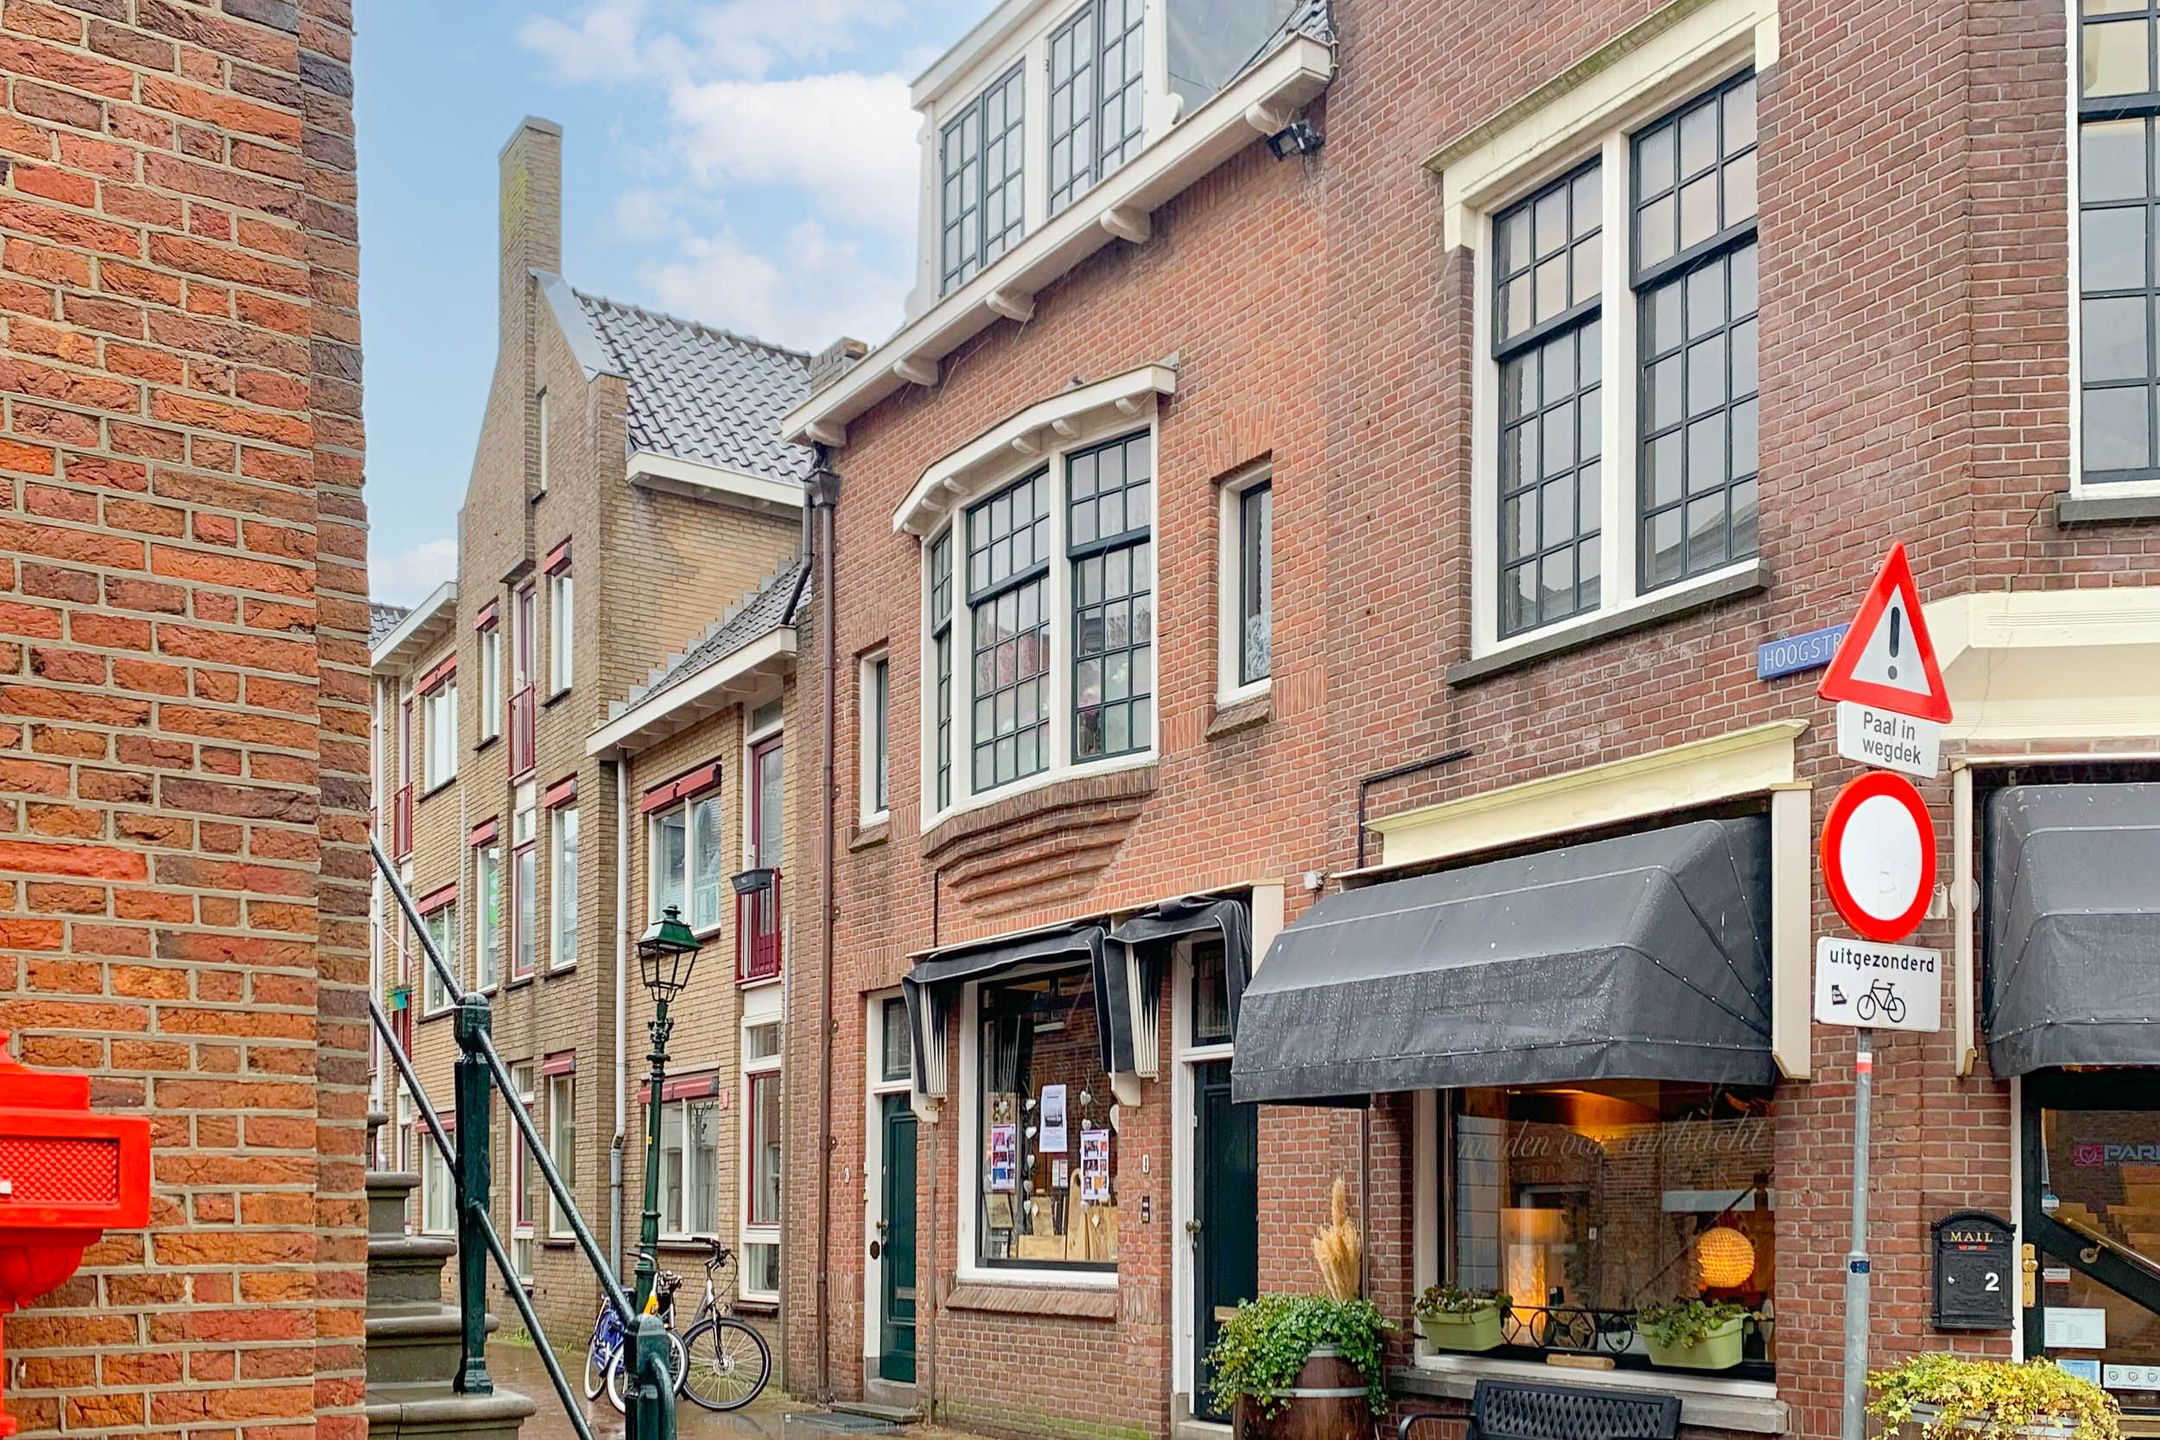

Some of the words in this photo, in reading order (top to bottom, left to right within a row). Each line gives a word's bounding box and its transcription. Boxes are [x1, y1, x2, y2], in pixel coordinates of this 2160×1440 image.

[1863, 711, 1896, 738] Paal
[1902, 720, 1915, 740] in
[1862, 737, 1921, 765] wegdek
[1829, 948, 1935, 973] uitgezonderd
[1950, 1230, 1994, 1243] MAIL
[1984, 1272, 2000, 1292] 2
